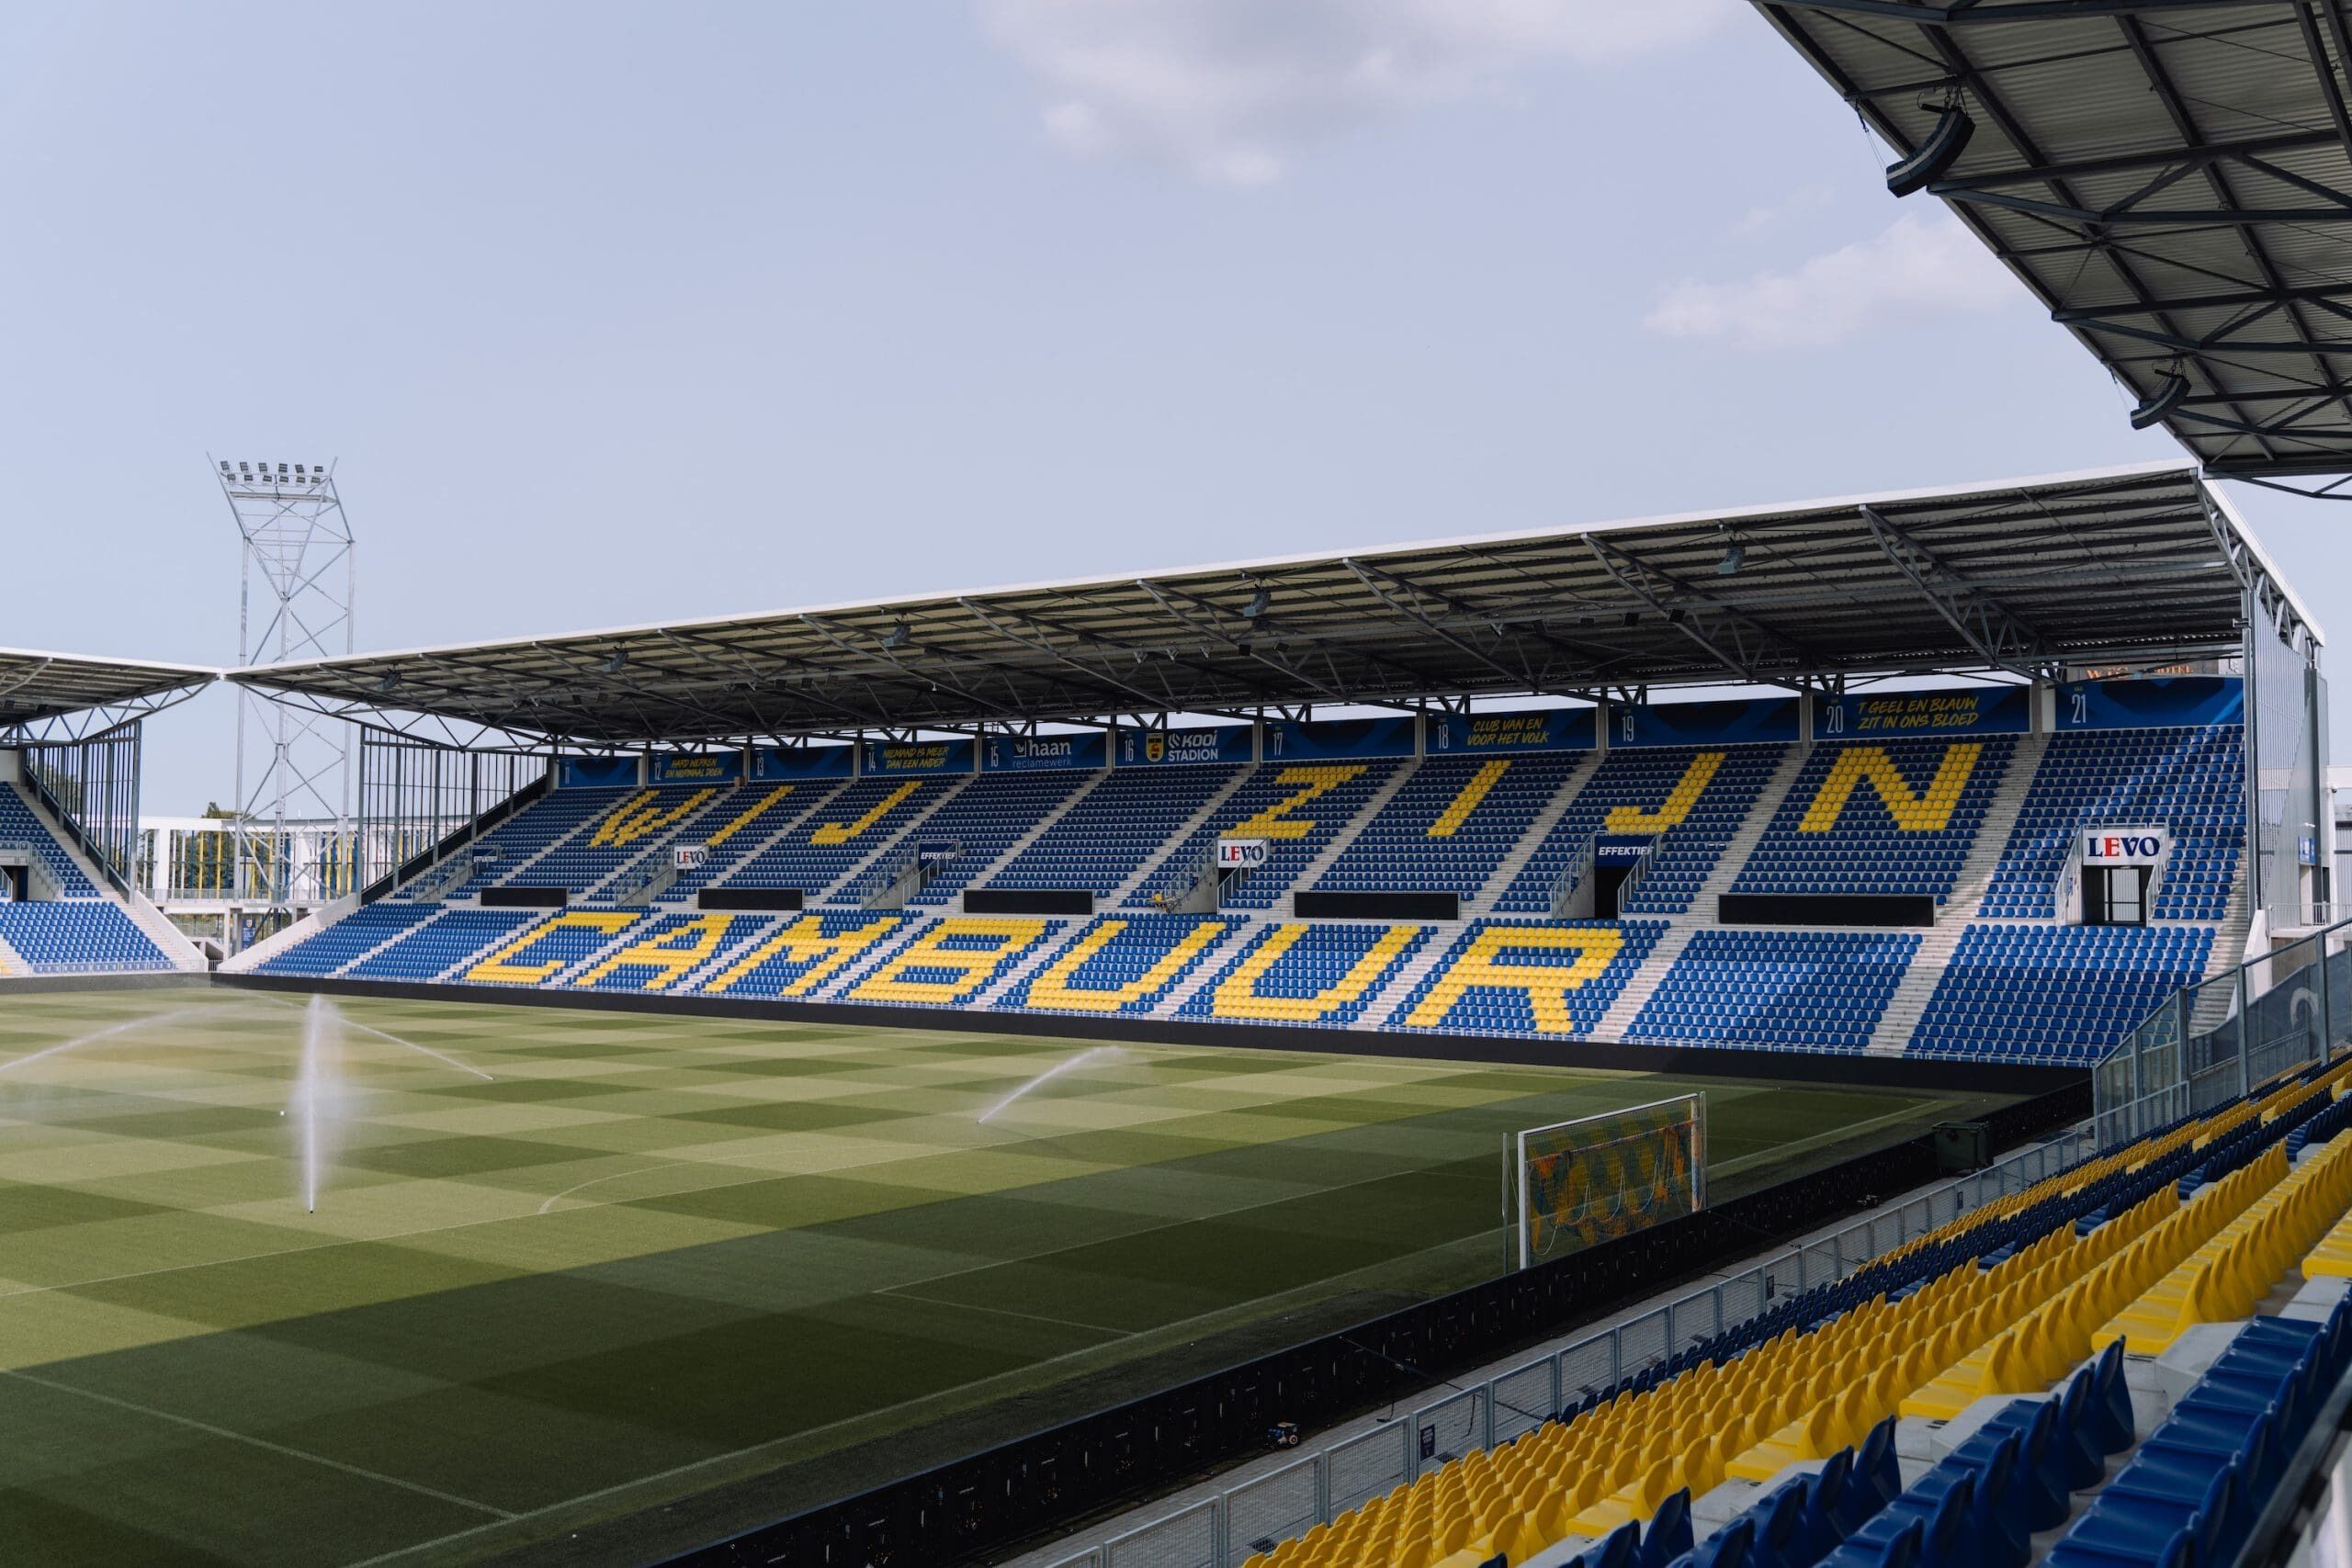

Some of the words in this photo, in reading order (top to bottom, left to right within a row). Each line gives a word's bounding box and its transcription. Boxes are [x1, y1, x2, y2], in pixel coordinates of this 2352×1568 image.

[1868, 700, 1905, 715] GEEL
[1907, 699, 1927, 714] EN
[1929, 696, 1980, 713] BLAUW
[2071, 694, 2086, 724] 21
[1473, 720, 1500, 732] CLUB
[1502, 718, 1525, 730] VAN
[1526, 716, 1544, 729] EN
[1622, 715, 1634, 742] 19
[1826, 705, 1844, 734] 20
[1858, 716, 1882, 730] ZIT
[1883, 715, 1899, 729] IN
[1899, 714, 1929, 728] ONS
[1931, 712, 1979, 728] BLOED
[1272, 732, 1283, 756] 17
[1437, 724, 1449, 750] 18
[1466, 733, 1497, 746] VOOR
[1497, 732, 1521, 745] HET
[1521, 730, 1550, 743] VOLK
[882, 748, 917, 759] NIEMAND
[917, 747, 925, 757] IS
[925, 746, 950, 757] MEER
[990, 745, 999, 768] 15
[1028, 739, 1072, 758] haan
[1125, 739, 1135, 762] 16
[1168, 749, 1219, 762] STADION
[654, 761, 662, 780] 12
[756, 759, 764, 777] 13
[868, 751, 876, 772] 14
[886, 759, 903, 769] DAN
[903, 758, 919, 769] EEN
[919, 757, 945, 768] ANDER
[1012, 757, 1072, 769] reclamewerk
[565, 766, 571, 784] 11
[1220, 743, 1983, 838] ZIJN
[921, 852, 956, 860] EFFEKTIEF
[1221, 844, 1264, 862] LEVO
[1598, 846, 1655, 856] EFFEKTIEF
[2087, 837, 2160, 857] LEVO
[676, 851, 706, 863] LEVO
[463, 911, 1626, 1033] CAMBUUR
